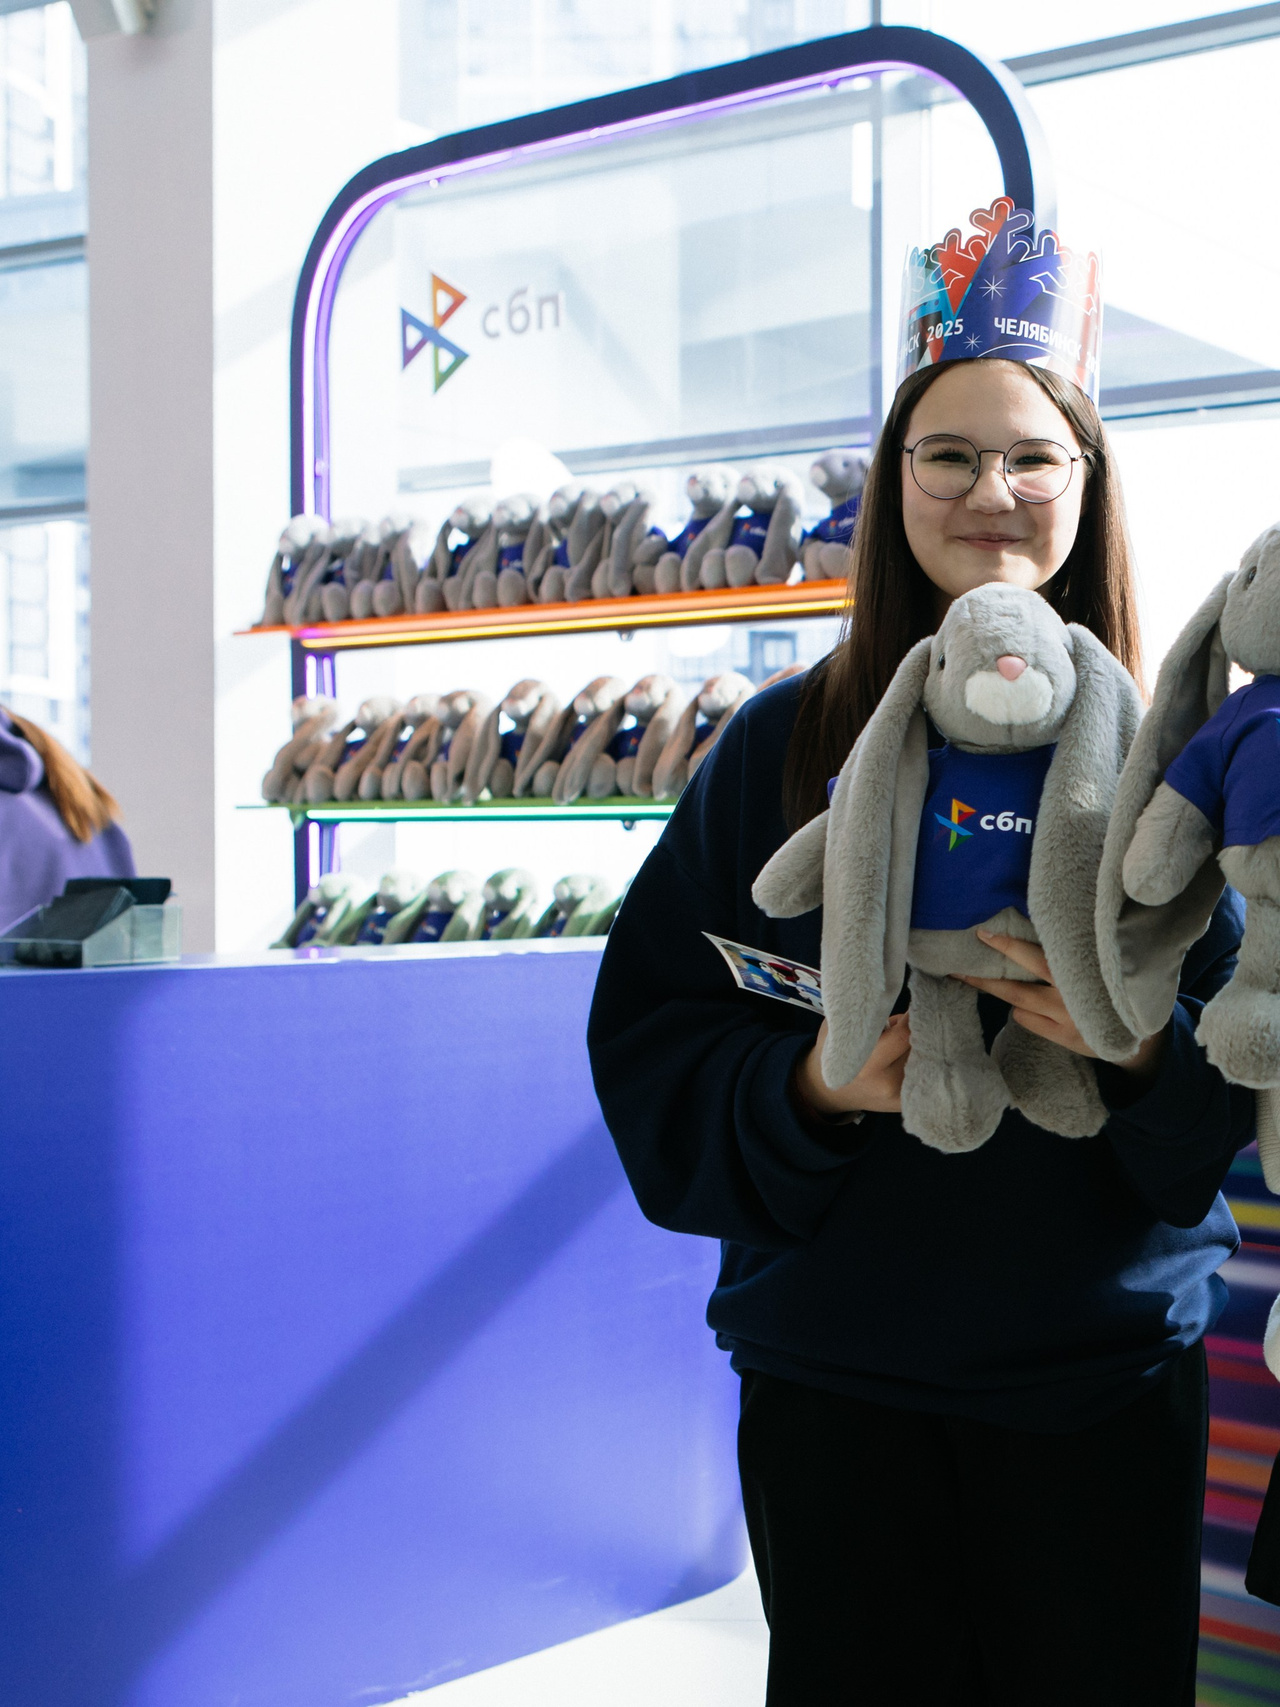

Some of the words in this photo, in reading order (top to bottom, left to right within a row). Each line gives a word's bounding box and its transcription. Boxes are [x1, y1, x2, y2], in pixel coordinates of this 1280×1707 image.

[481, 284, 562, 340] сбп
[926, 318, 964, 343] 2025
[993, 317, 1082, 362] ЧЕЛЯБИНСК
[979, 811, 1033, 835] сбп
